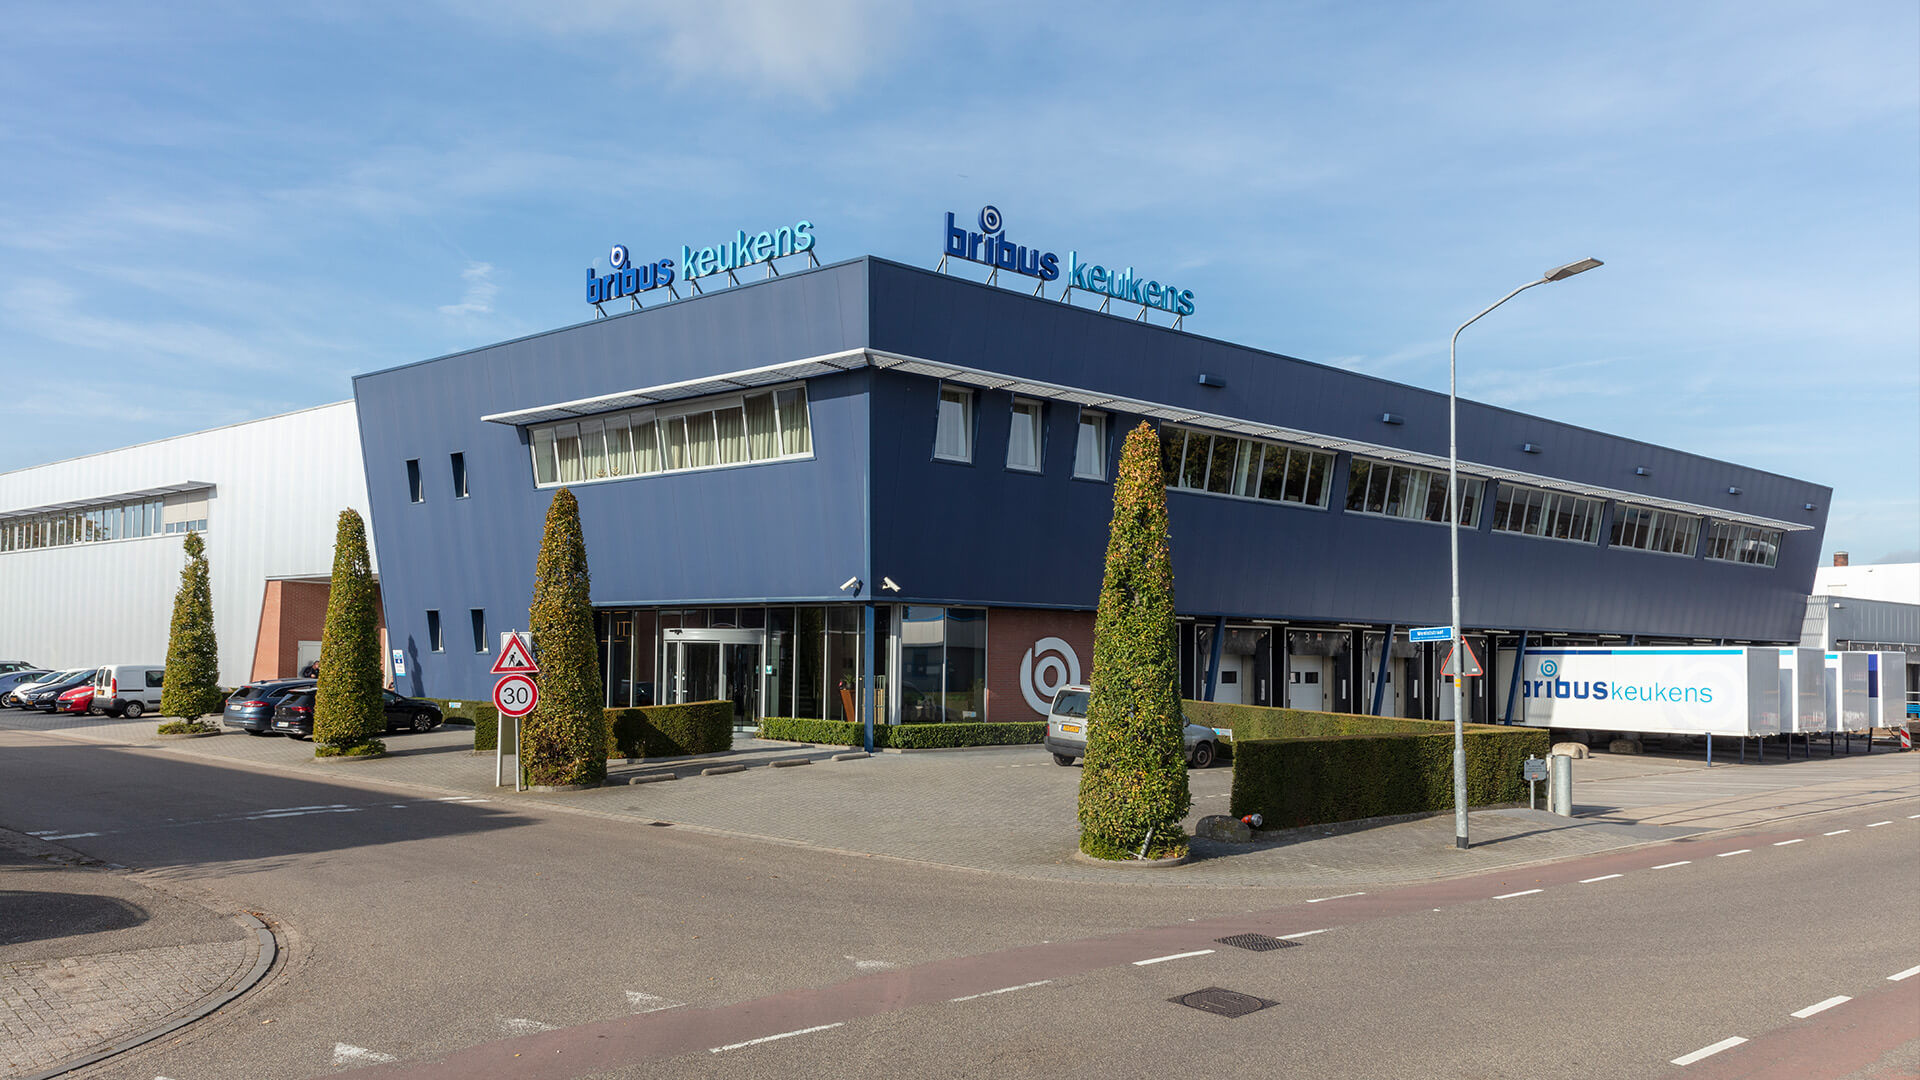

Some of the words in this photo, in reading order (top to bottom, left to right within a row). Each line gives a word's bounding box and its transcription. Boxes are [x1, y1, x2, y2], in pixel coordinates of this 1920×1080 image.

[586, 244, 675, 304] bribus
[681, 220, 815, 281] keukens
[944, 205, 1060, 281] bribus
[1068, 251, 1195, 315] keukens
[504, 687, 528, 704] 30
